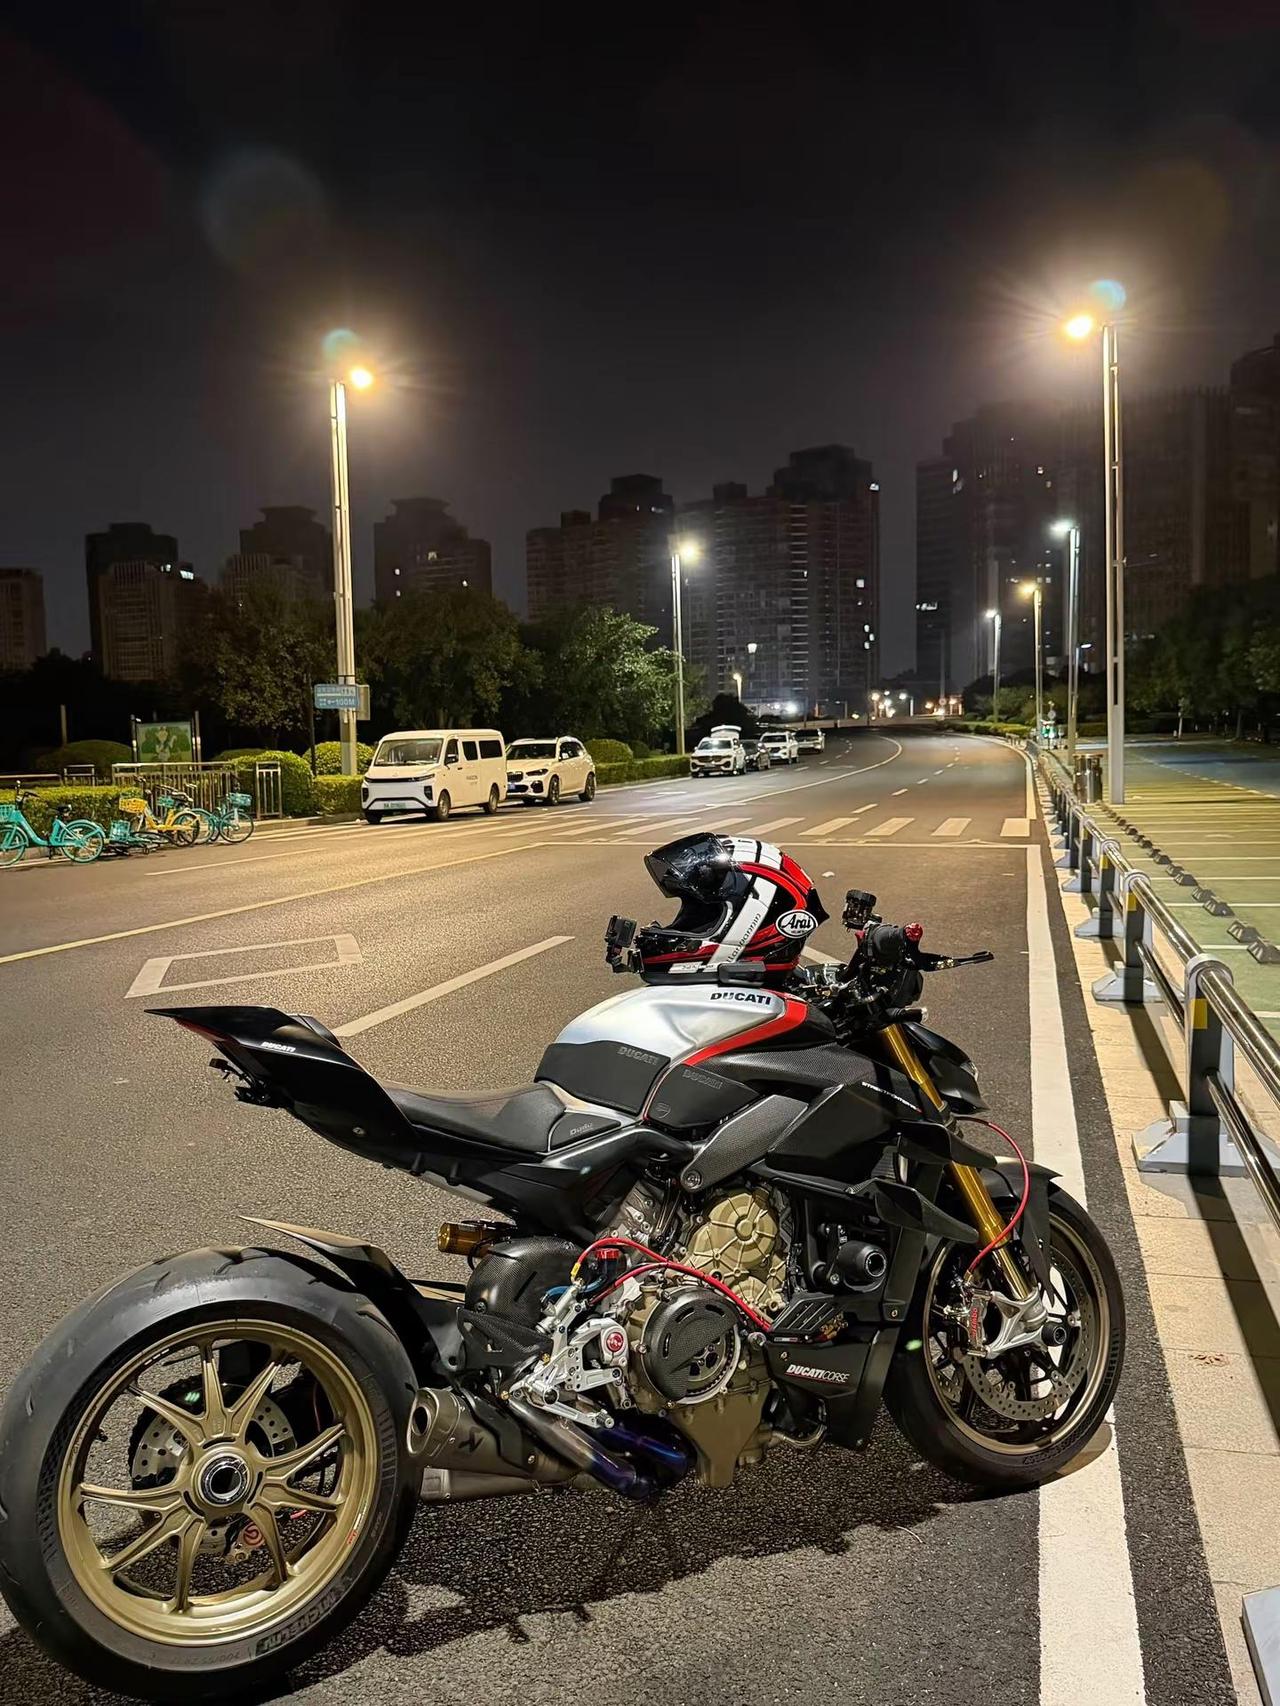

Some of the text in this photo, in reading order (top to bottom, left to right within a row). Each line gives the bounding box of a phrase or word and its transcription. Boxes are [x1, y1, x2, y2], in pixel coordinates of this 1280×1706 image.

[781, 914, 811, 929] Arai
[710, 992, 772, 1005] DUCATI
[261, 1041, 296, 1052] DUCATI
[617, 1046, 659, 1065] DUCATI
[682, 1069, 723, 1089] DUCATI
